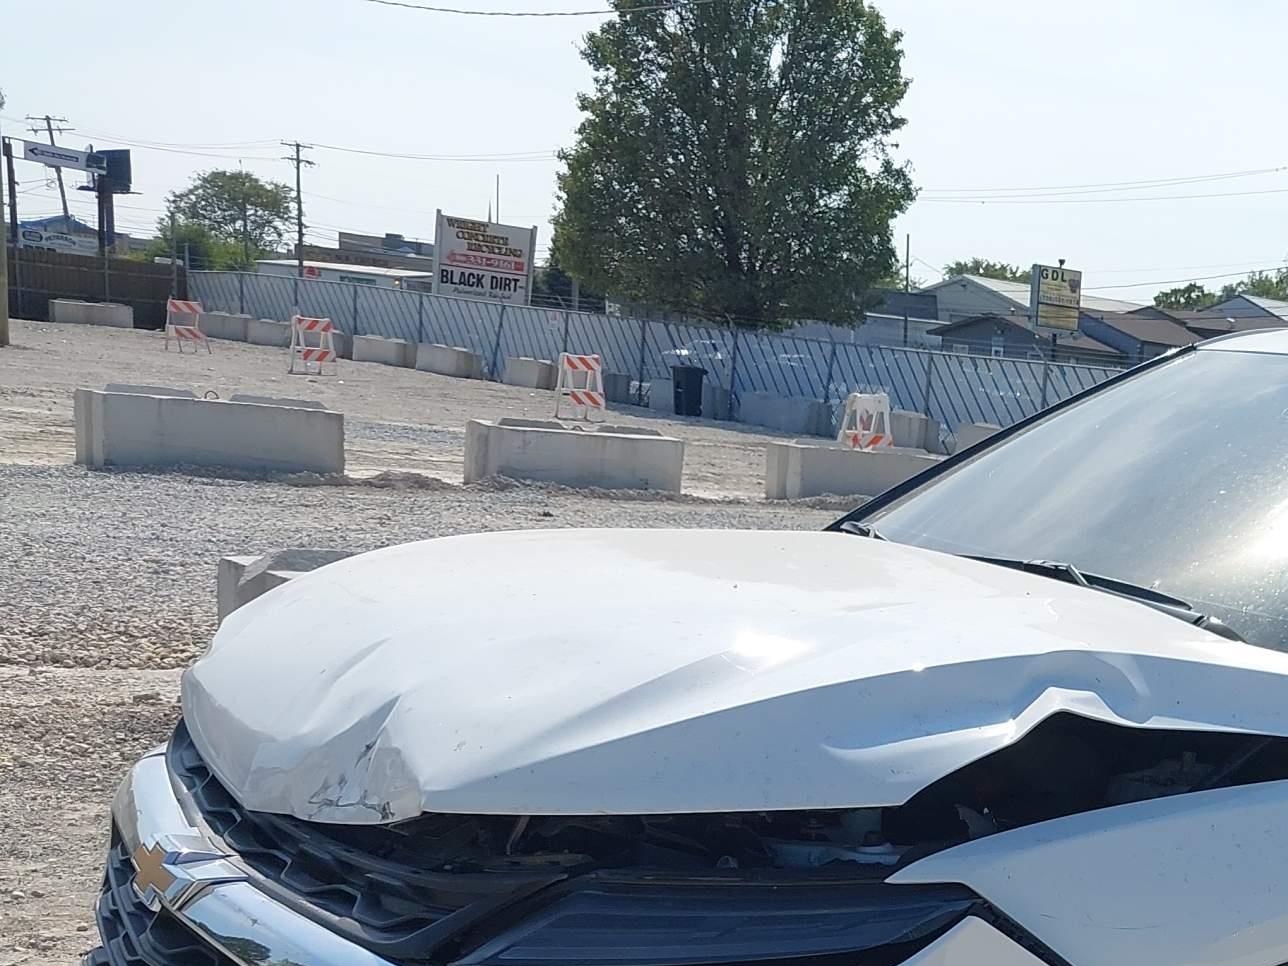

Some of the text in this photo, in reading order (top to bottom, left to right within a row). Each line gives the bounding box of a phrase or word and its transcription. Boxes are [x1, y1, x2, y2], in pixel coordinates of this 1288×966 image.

[446, 218, 489, 233] WRIGHT
[456, 230, 509, 246] CONCRETE
[466, 242, 523, 258] RECYCLING
[440, 269, 485, 289] BLACK
[1041, 268, 1067, 283] GDL
